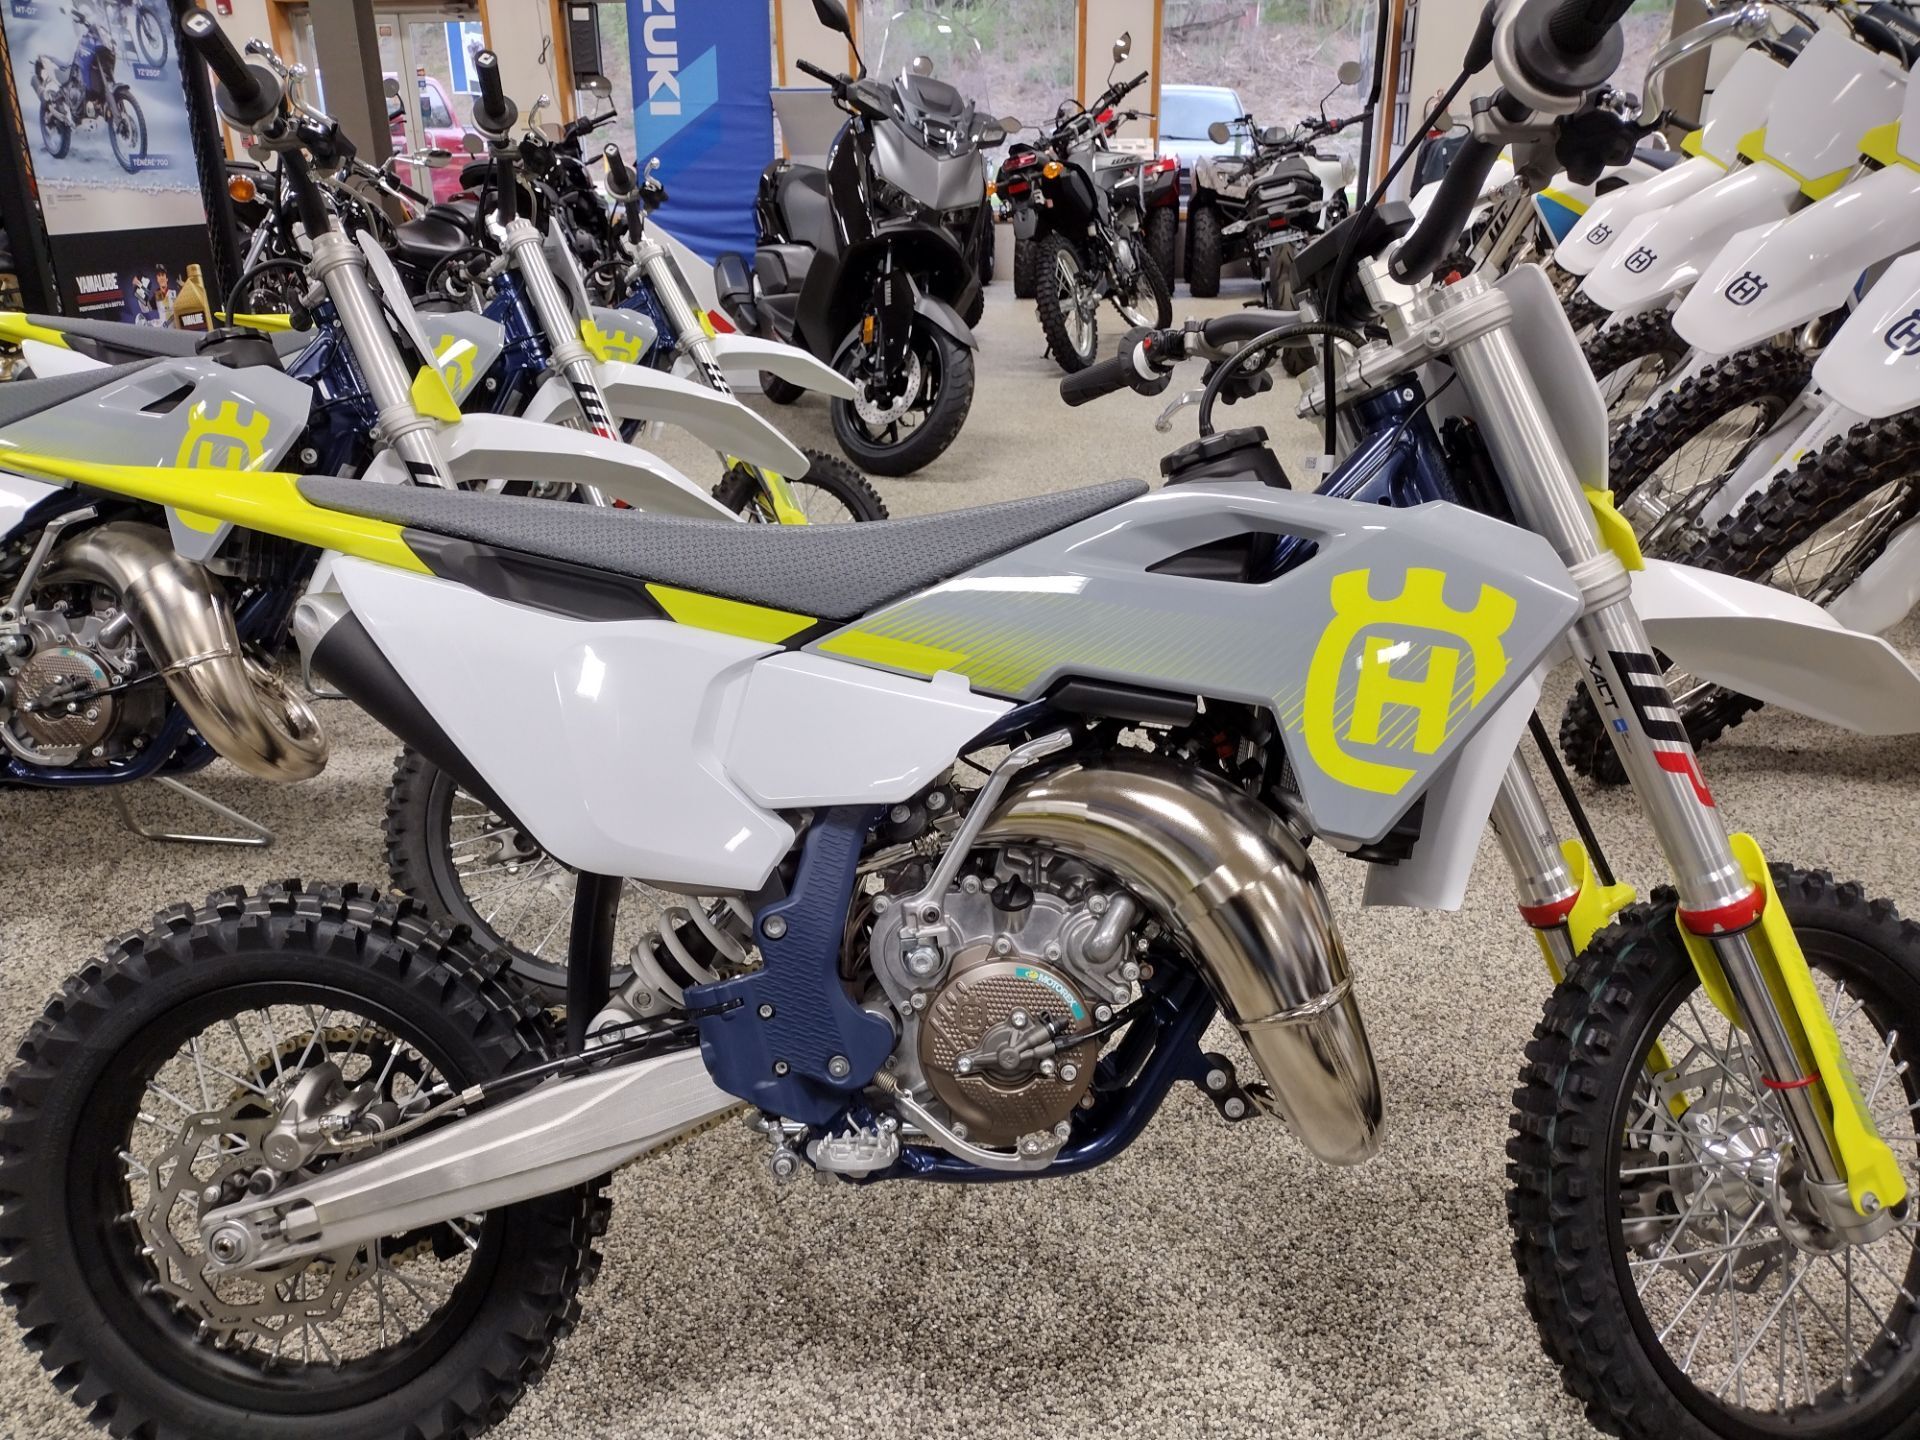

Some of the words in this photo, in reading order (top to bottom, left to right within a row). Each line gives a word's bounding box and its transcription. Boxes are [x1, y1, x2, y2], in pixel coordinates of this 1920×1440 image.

[75, 272, 119, 294] YAMALUBE
[1584, 655, 1620, 710] XACT
[1038, 973, 1078, 1008] MOTOREX
